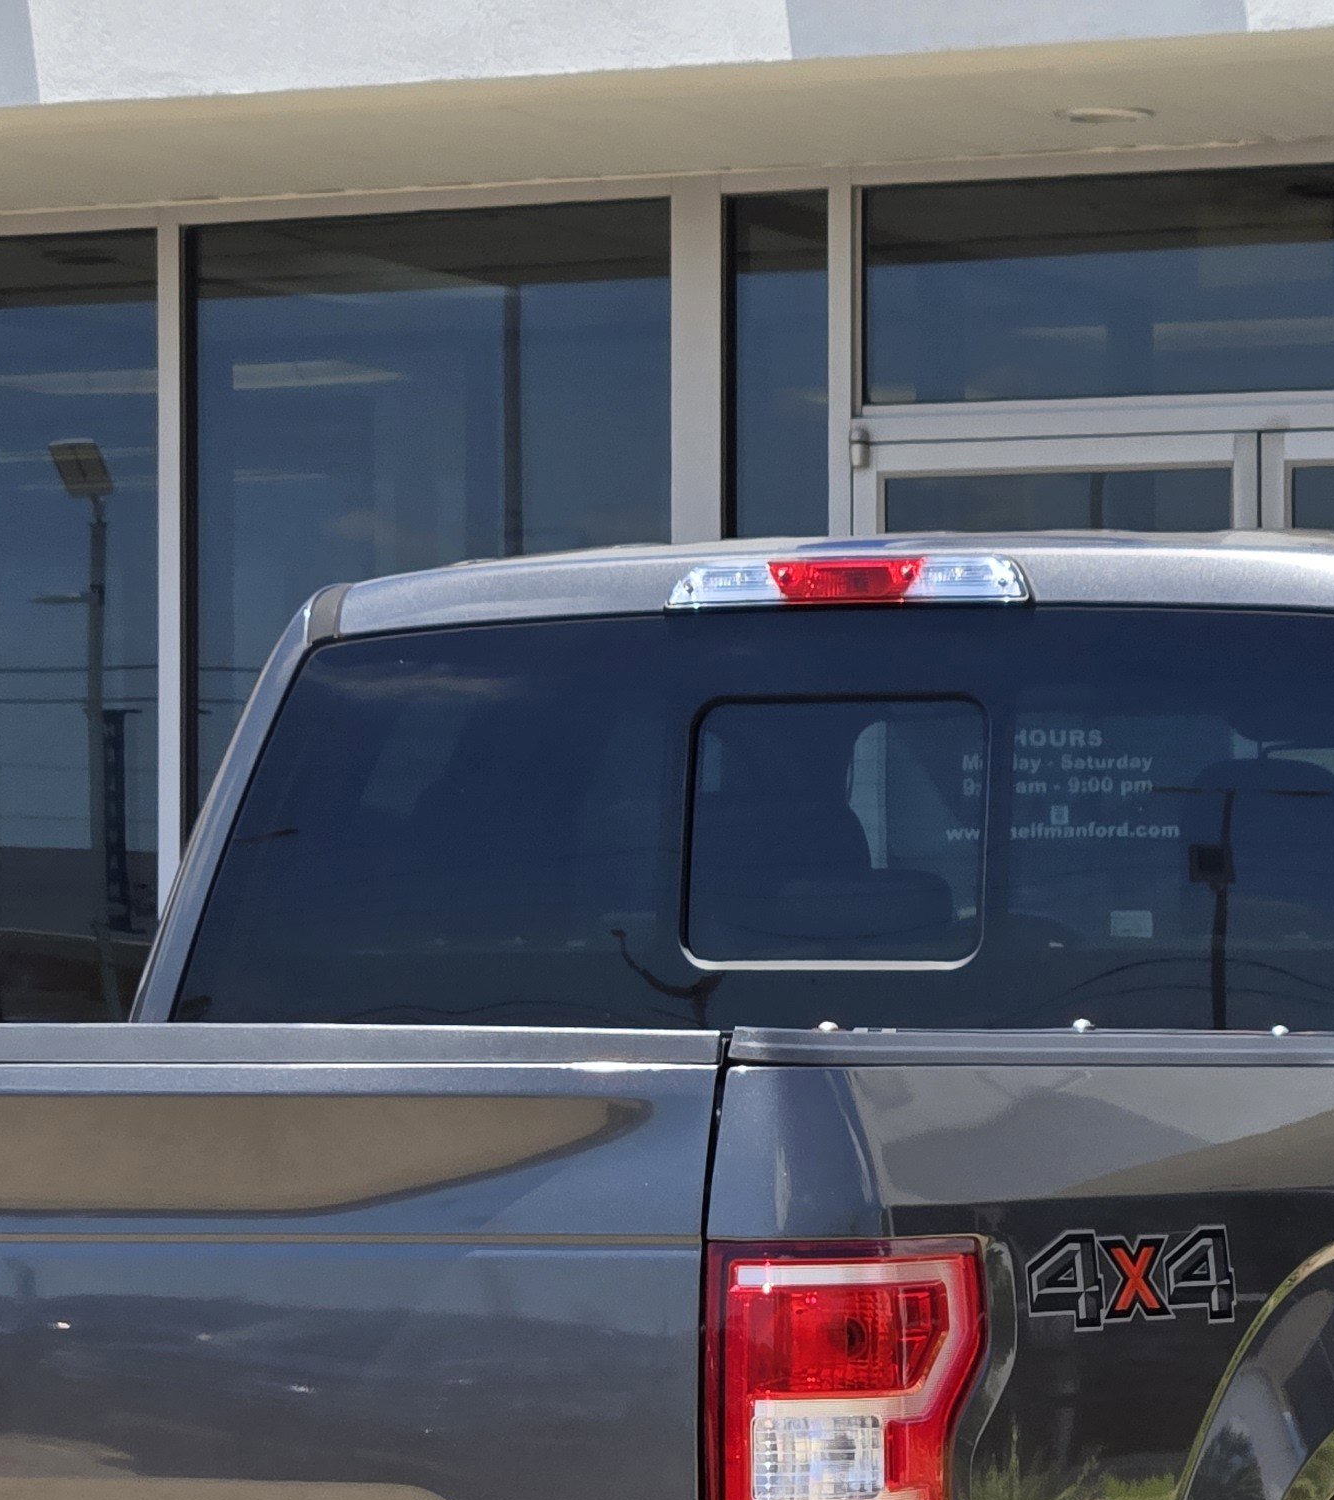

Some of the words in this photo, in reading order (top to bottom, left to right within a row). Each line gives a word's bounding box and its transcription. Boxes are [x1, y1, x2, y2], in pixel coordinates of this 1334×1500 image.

[1060, 753, 1154, 773] Saturday
[1067, 776, 1114, 794] 9:00
[1120, 779, 1153, 796] pm
